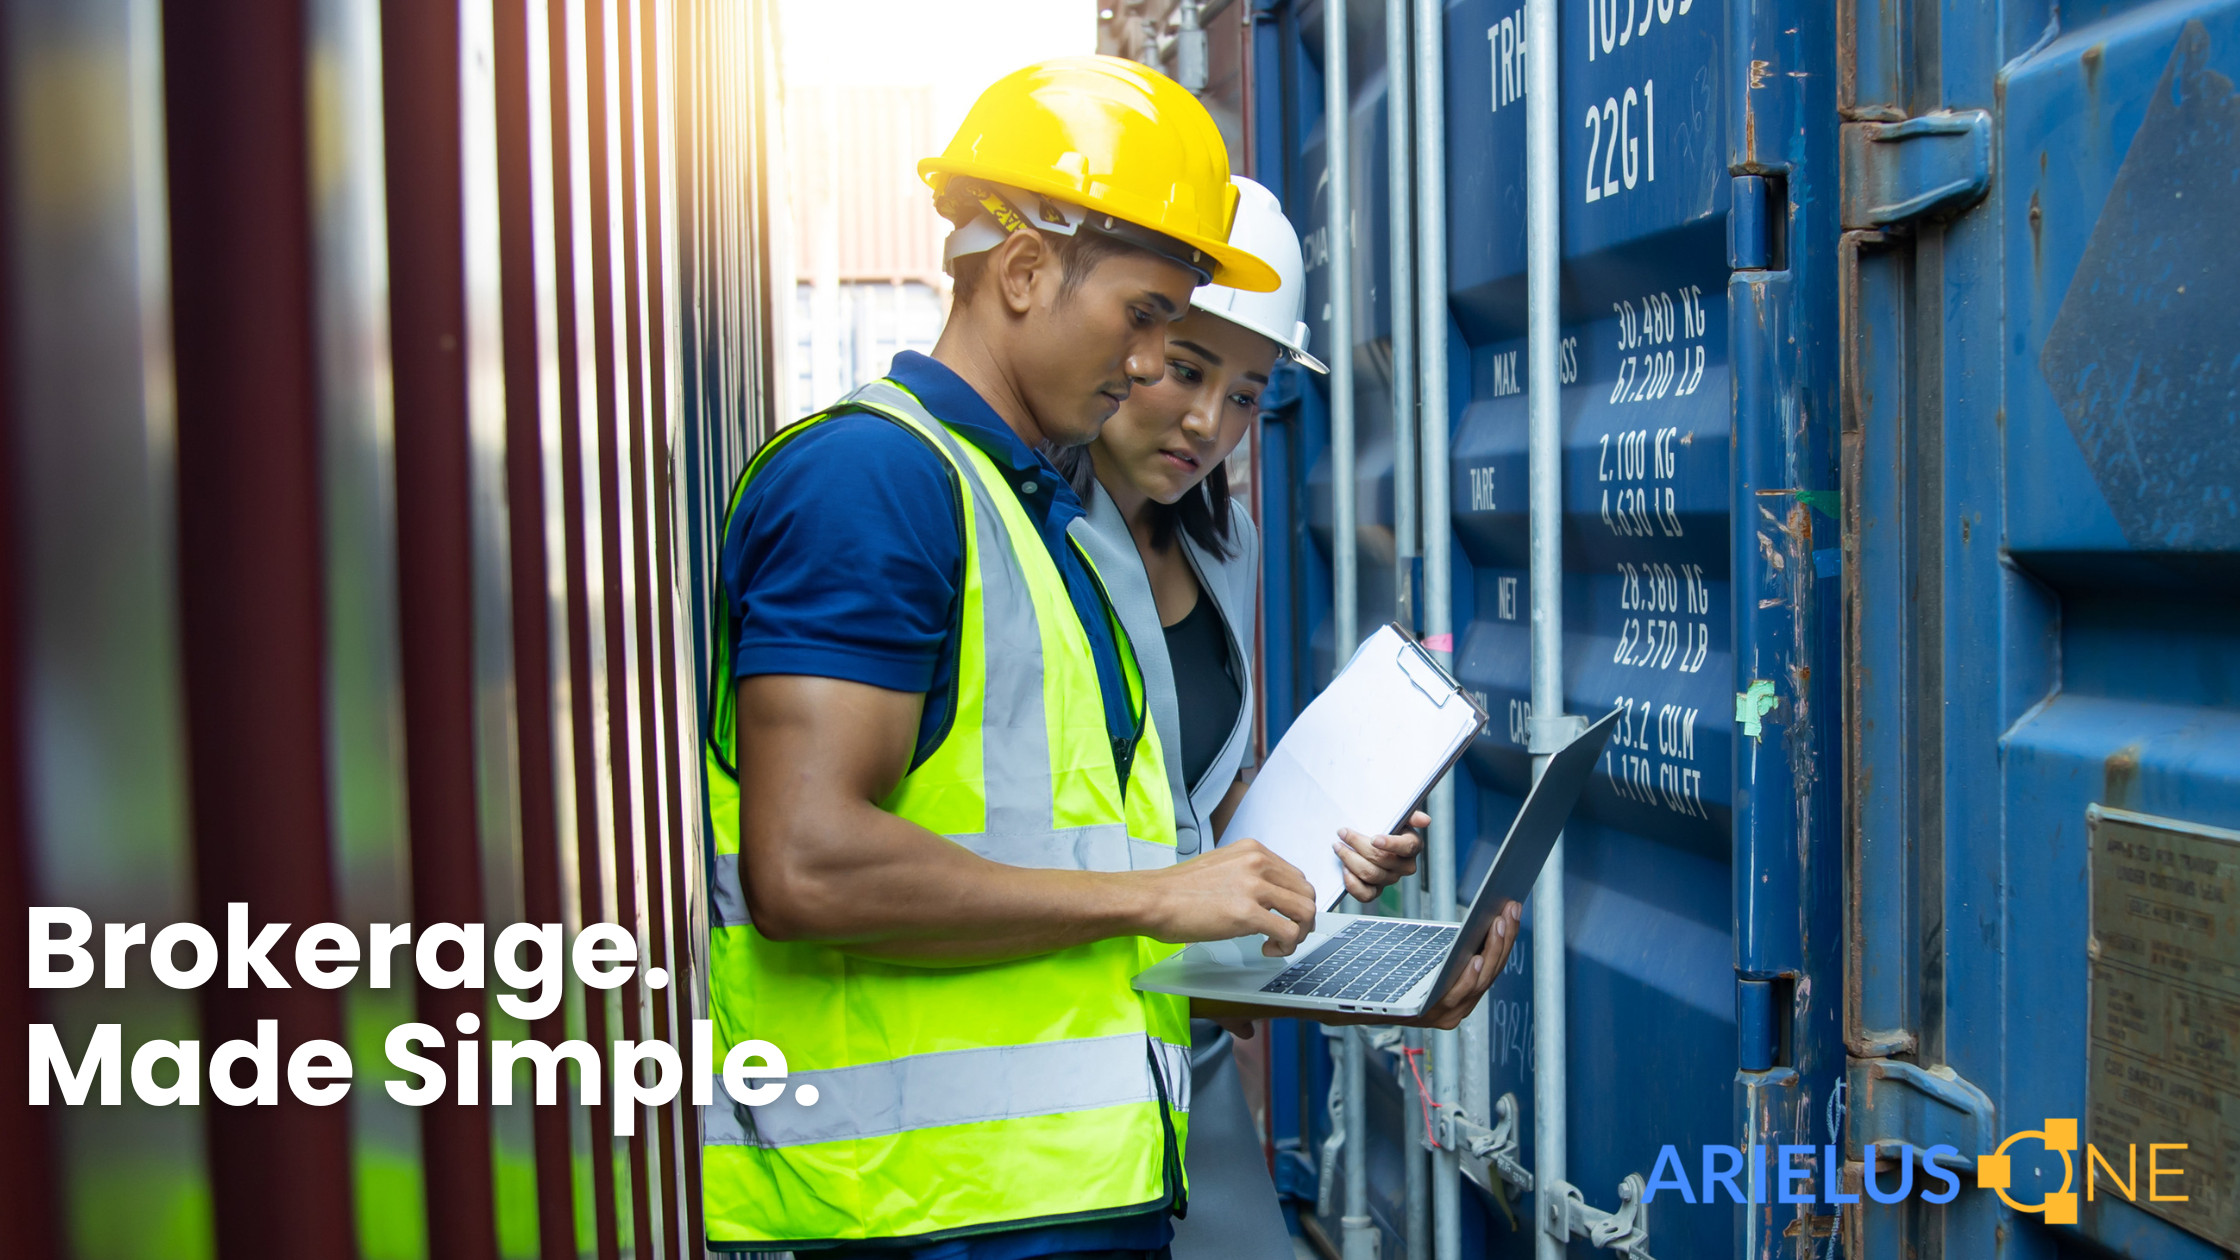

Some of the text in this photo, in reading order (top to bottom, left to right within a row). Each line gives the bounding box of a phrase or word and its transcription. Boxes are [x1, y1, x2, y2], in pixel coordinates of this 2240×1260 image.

[1586, 79, 1655, 203] 22G1
[1494, 350, 1520, 397] MAX.
[1613, 291, 1675, 351] 30,480
[1679, 284, 1705, 339] KG
[1609, 345, 1705, 405] 67,200 LB
[1470, 426, 1677, 511] TARE 2,100 KG
[1601, 487, 1683, 537] 4,630 LB
[1498, 562, 1708, 621] NET 28,380 KG
[1613, 617, 1708, 674] 62,570 LB
[1658, 703, 1698, 761] CU.M
[1606, 750, 1708, 821] 1,170 CU.FT
